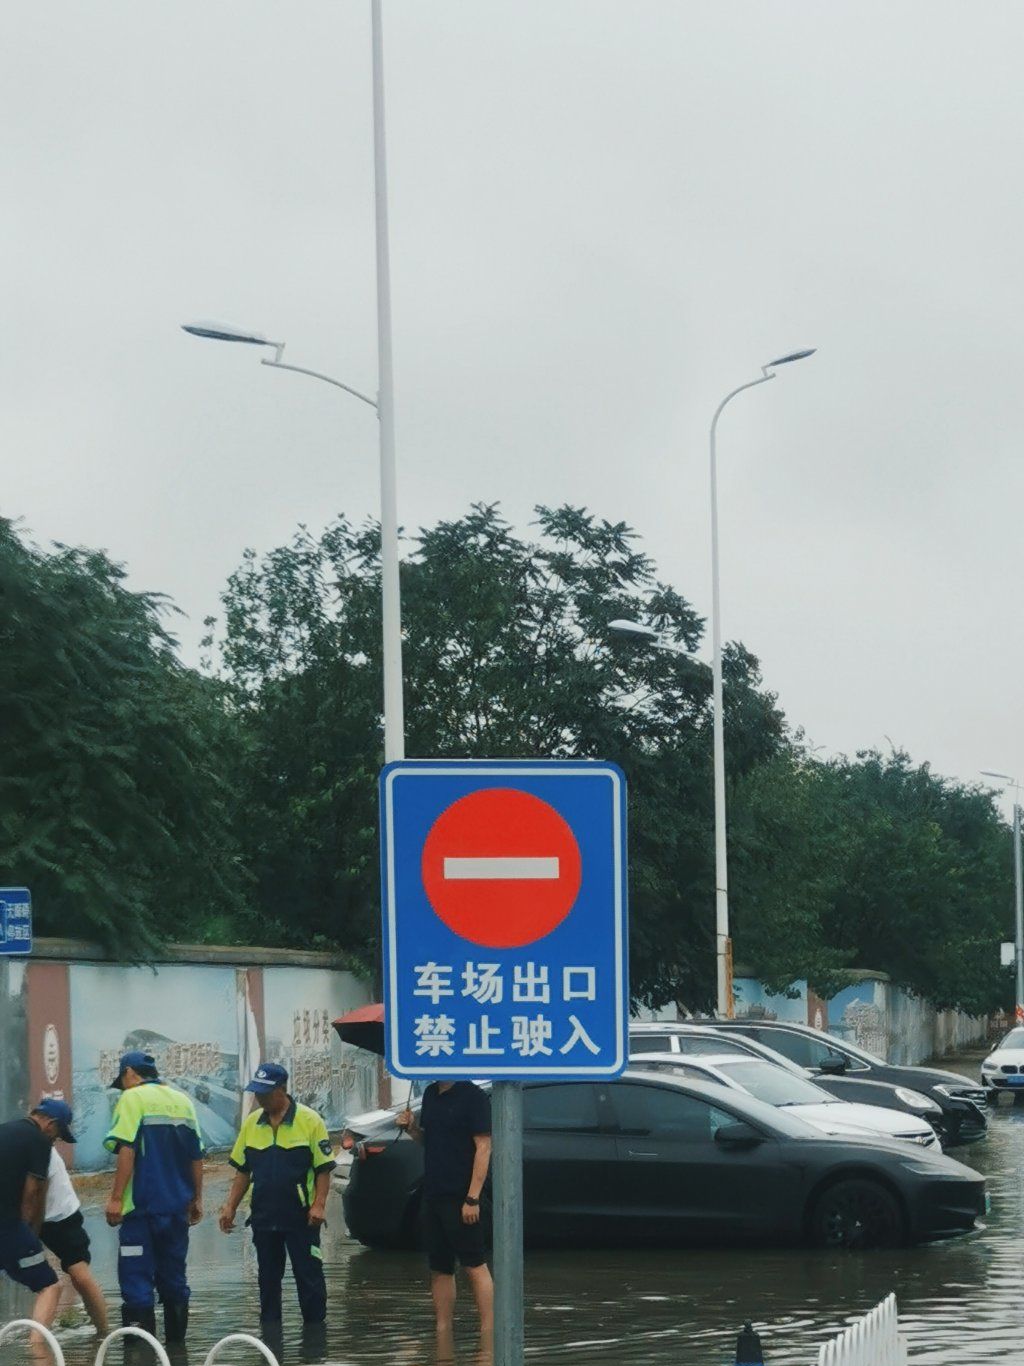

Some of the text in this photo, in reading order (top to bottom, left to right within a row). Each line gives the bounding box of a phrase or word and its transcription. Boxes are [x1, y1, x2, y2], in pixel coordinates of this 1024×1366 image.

[413, 961, 597, 1005] 车场出口
[413, 1013, 601, 1057] 禁止驶入
